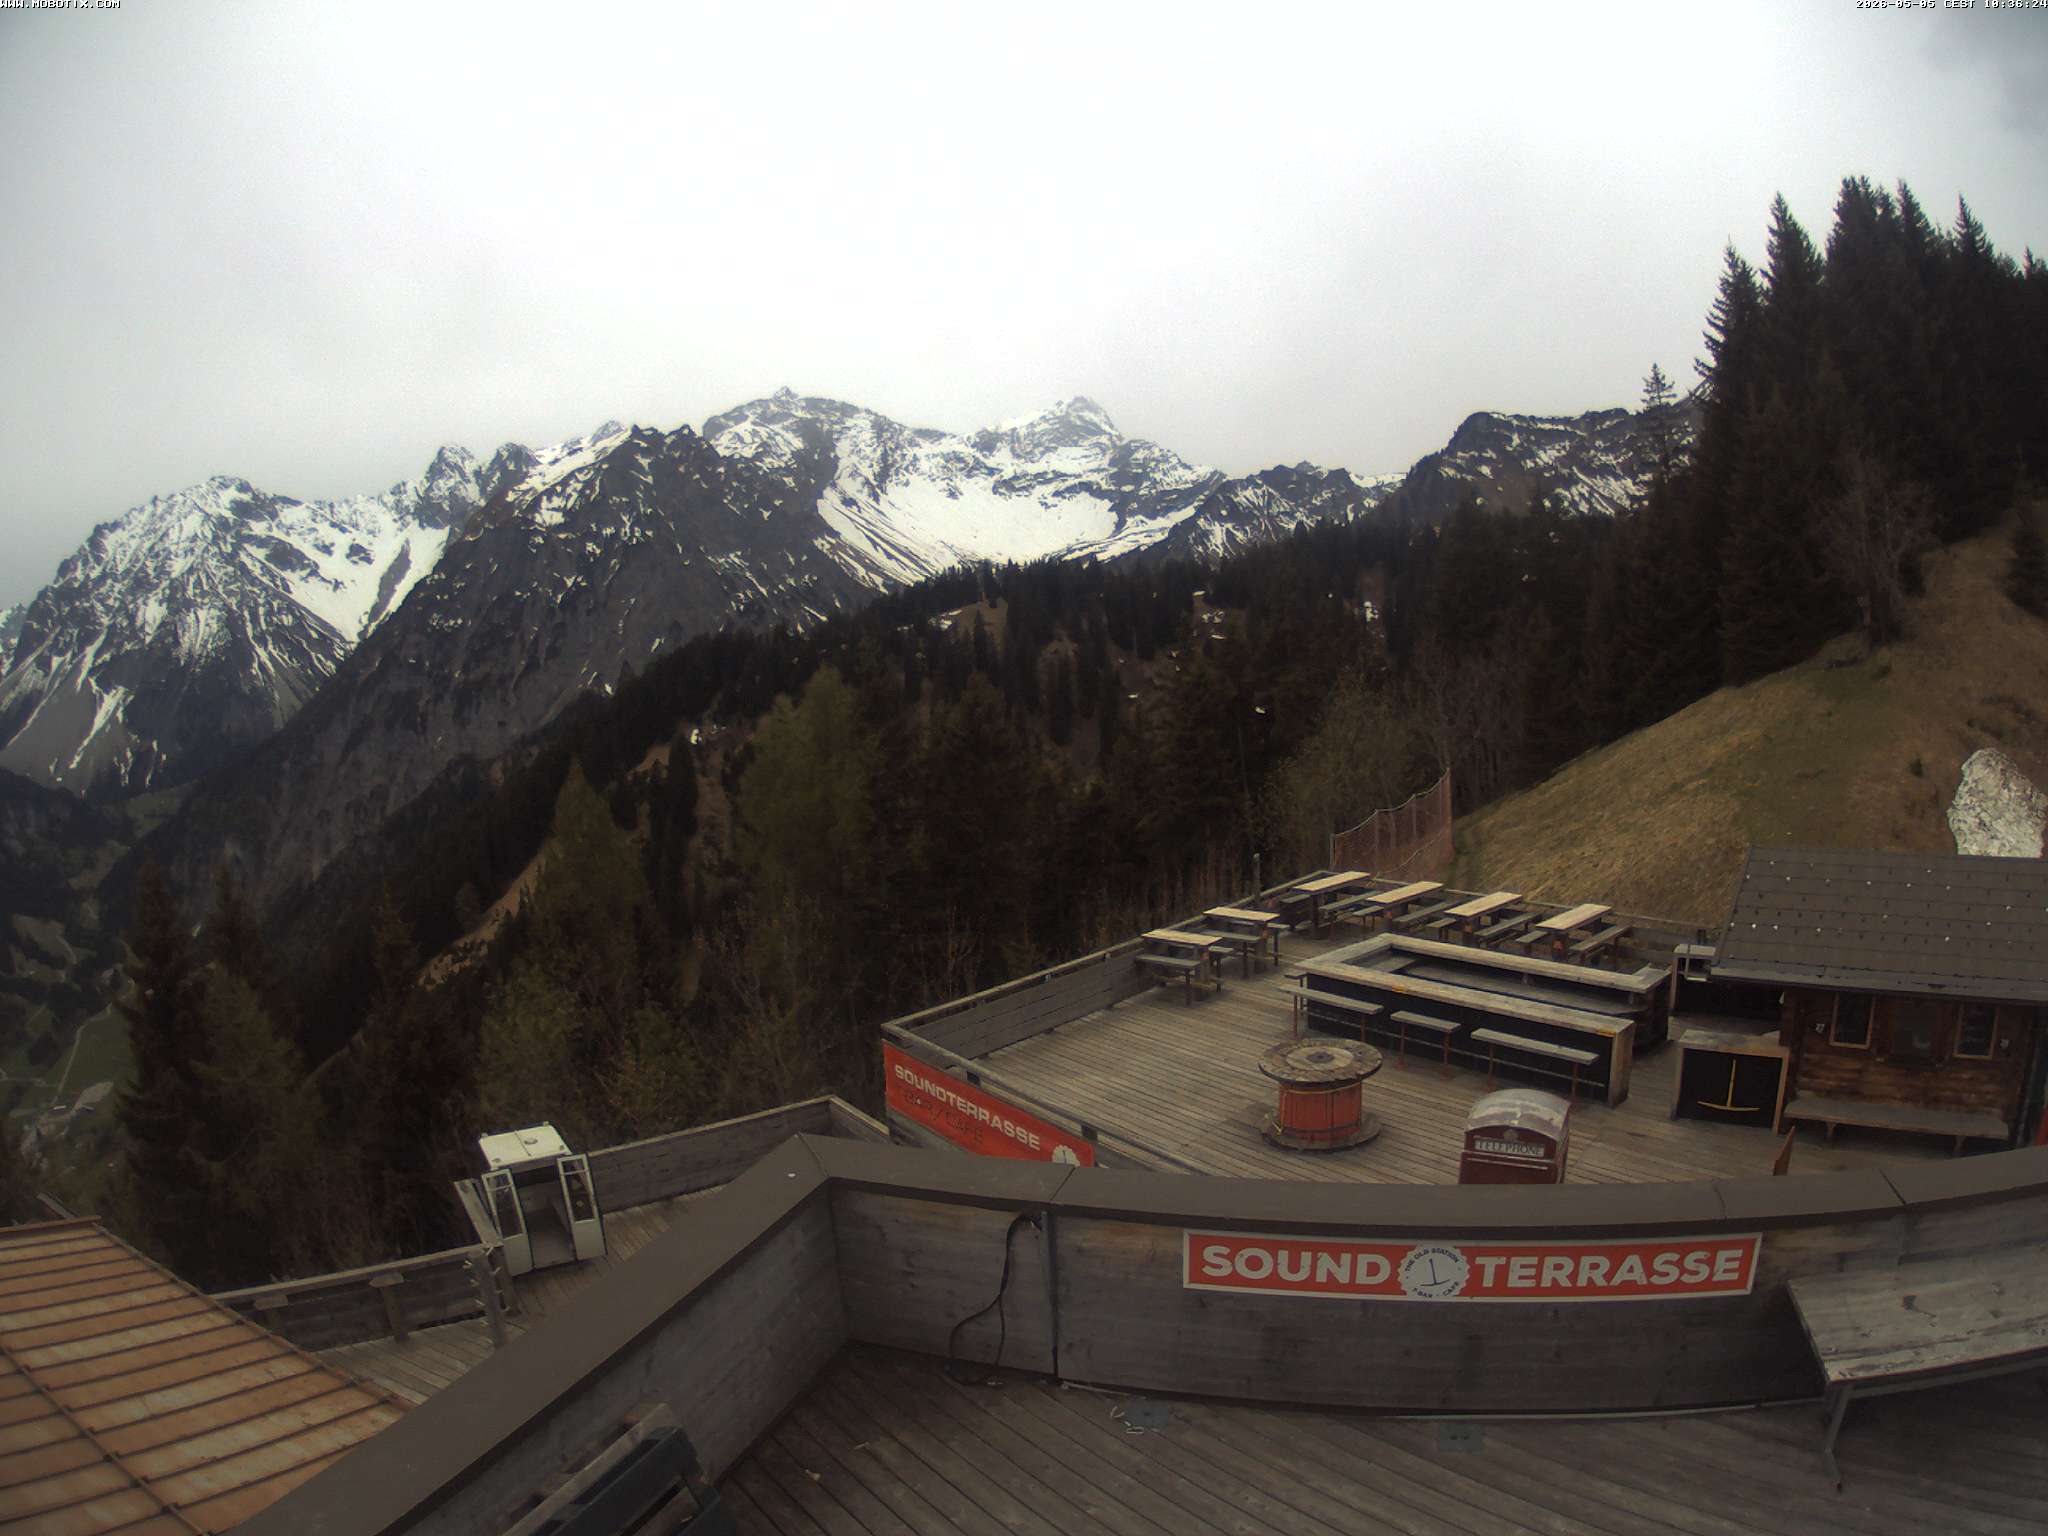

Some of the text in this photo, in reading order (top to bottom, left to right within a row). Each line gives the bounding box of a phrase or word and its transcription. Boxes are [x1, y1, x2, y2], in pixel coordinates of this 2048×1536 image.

[895, 1064, 1040, 1150] SOUNDTERRASSE
[1201, 1244, 1743, 1288] SOUND TERRASSE
